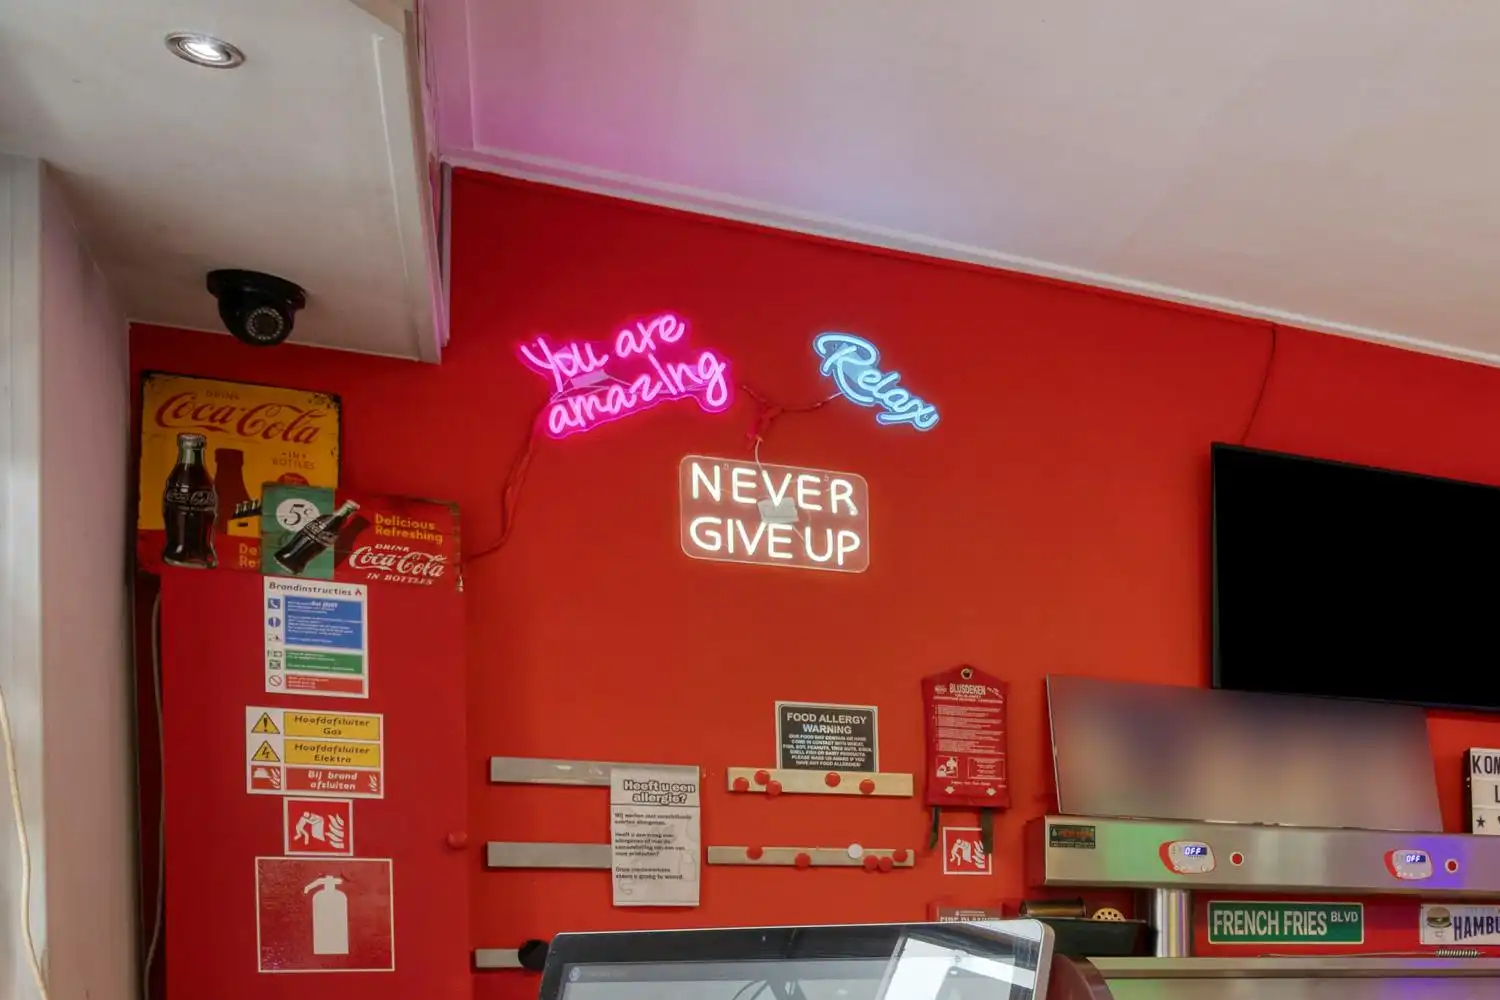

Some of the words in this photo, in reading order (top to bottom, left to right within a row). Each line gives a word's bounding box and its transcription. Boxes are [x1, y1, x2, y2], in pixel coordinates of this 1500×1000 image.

[519, 336, 608, 393] You
[616, 313, 685, 359] are
[815, 334, 939, 429] Relax
[549, 350, 727, 434] amazing
[690, 462, 858, 516] NEVER
[375, 513, 436, 530] Delicious
[375, 525, 443, 545] Refreshing
[689, 517, 793, 559] GIVE
[804, 528, 860, 566] UP
[268, 582, 353, 597] Brandinstructies
[786, 712, 817, 722] FOOD
[818, 714, 867, 724] ALLERGY
[323, 727, 342, 736] Gas
[802, 724, 853, 734] WARNING
[313, 753, 352, 764] Elektra
[331, 770, 358, 782] brand
[309, 779, 356, 791] afsluiten
[623, 779, 660, 793] Heeft
[659, 782, 670, 793] u
[671, 784, 697, 793] een
[631, 792, 688, 805] allergie?
[1183, 845, 1201, 856] OFF
[1405, 854, 1421, 863] OFF
[1213, 910, 1280, 936] FRENCH
[1283, 911, 1329, 937] FRIES
[1330, 911, 1359, 924] BLVD
